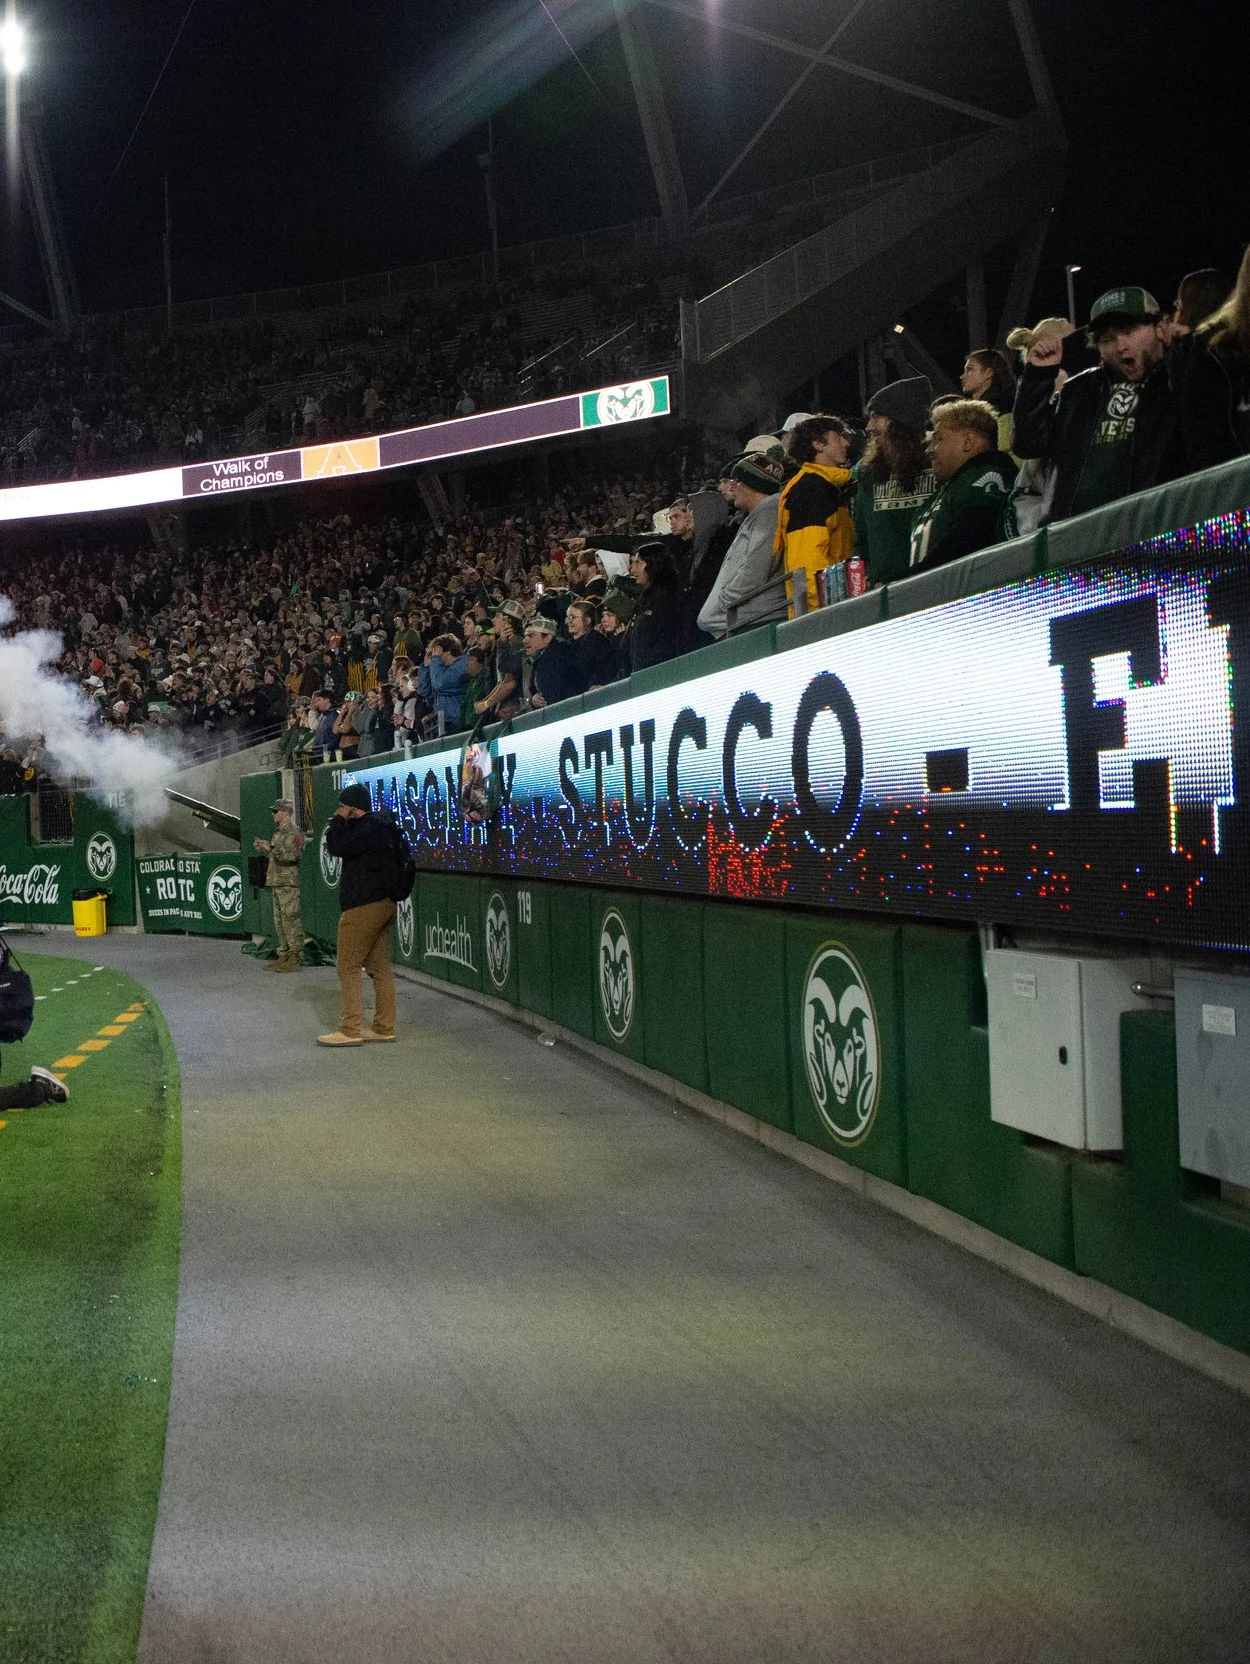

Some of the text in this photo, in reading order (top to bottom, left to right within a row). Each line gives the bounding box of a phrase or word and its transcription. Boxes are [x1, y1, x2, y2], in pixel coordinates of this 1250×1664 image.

[212, 456, 270, 477] Walk of
[199, 468, 285, 492] Champions
[558, 669, 866, 853] STUCCO
[185, 861, 201, 874] STA
[156, 877, 196, 902] ROTC
[517, 890, 532, 925] 119
[425, 911, 473, 964] uchealth
